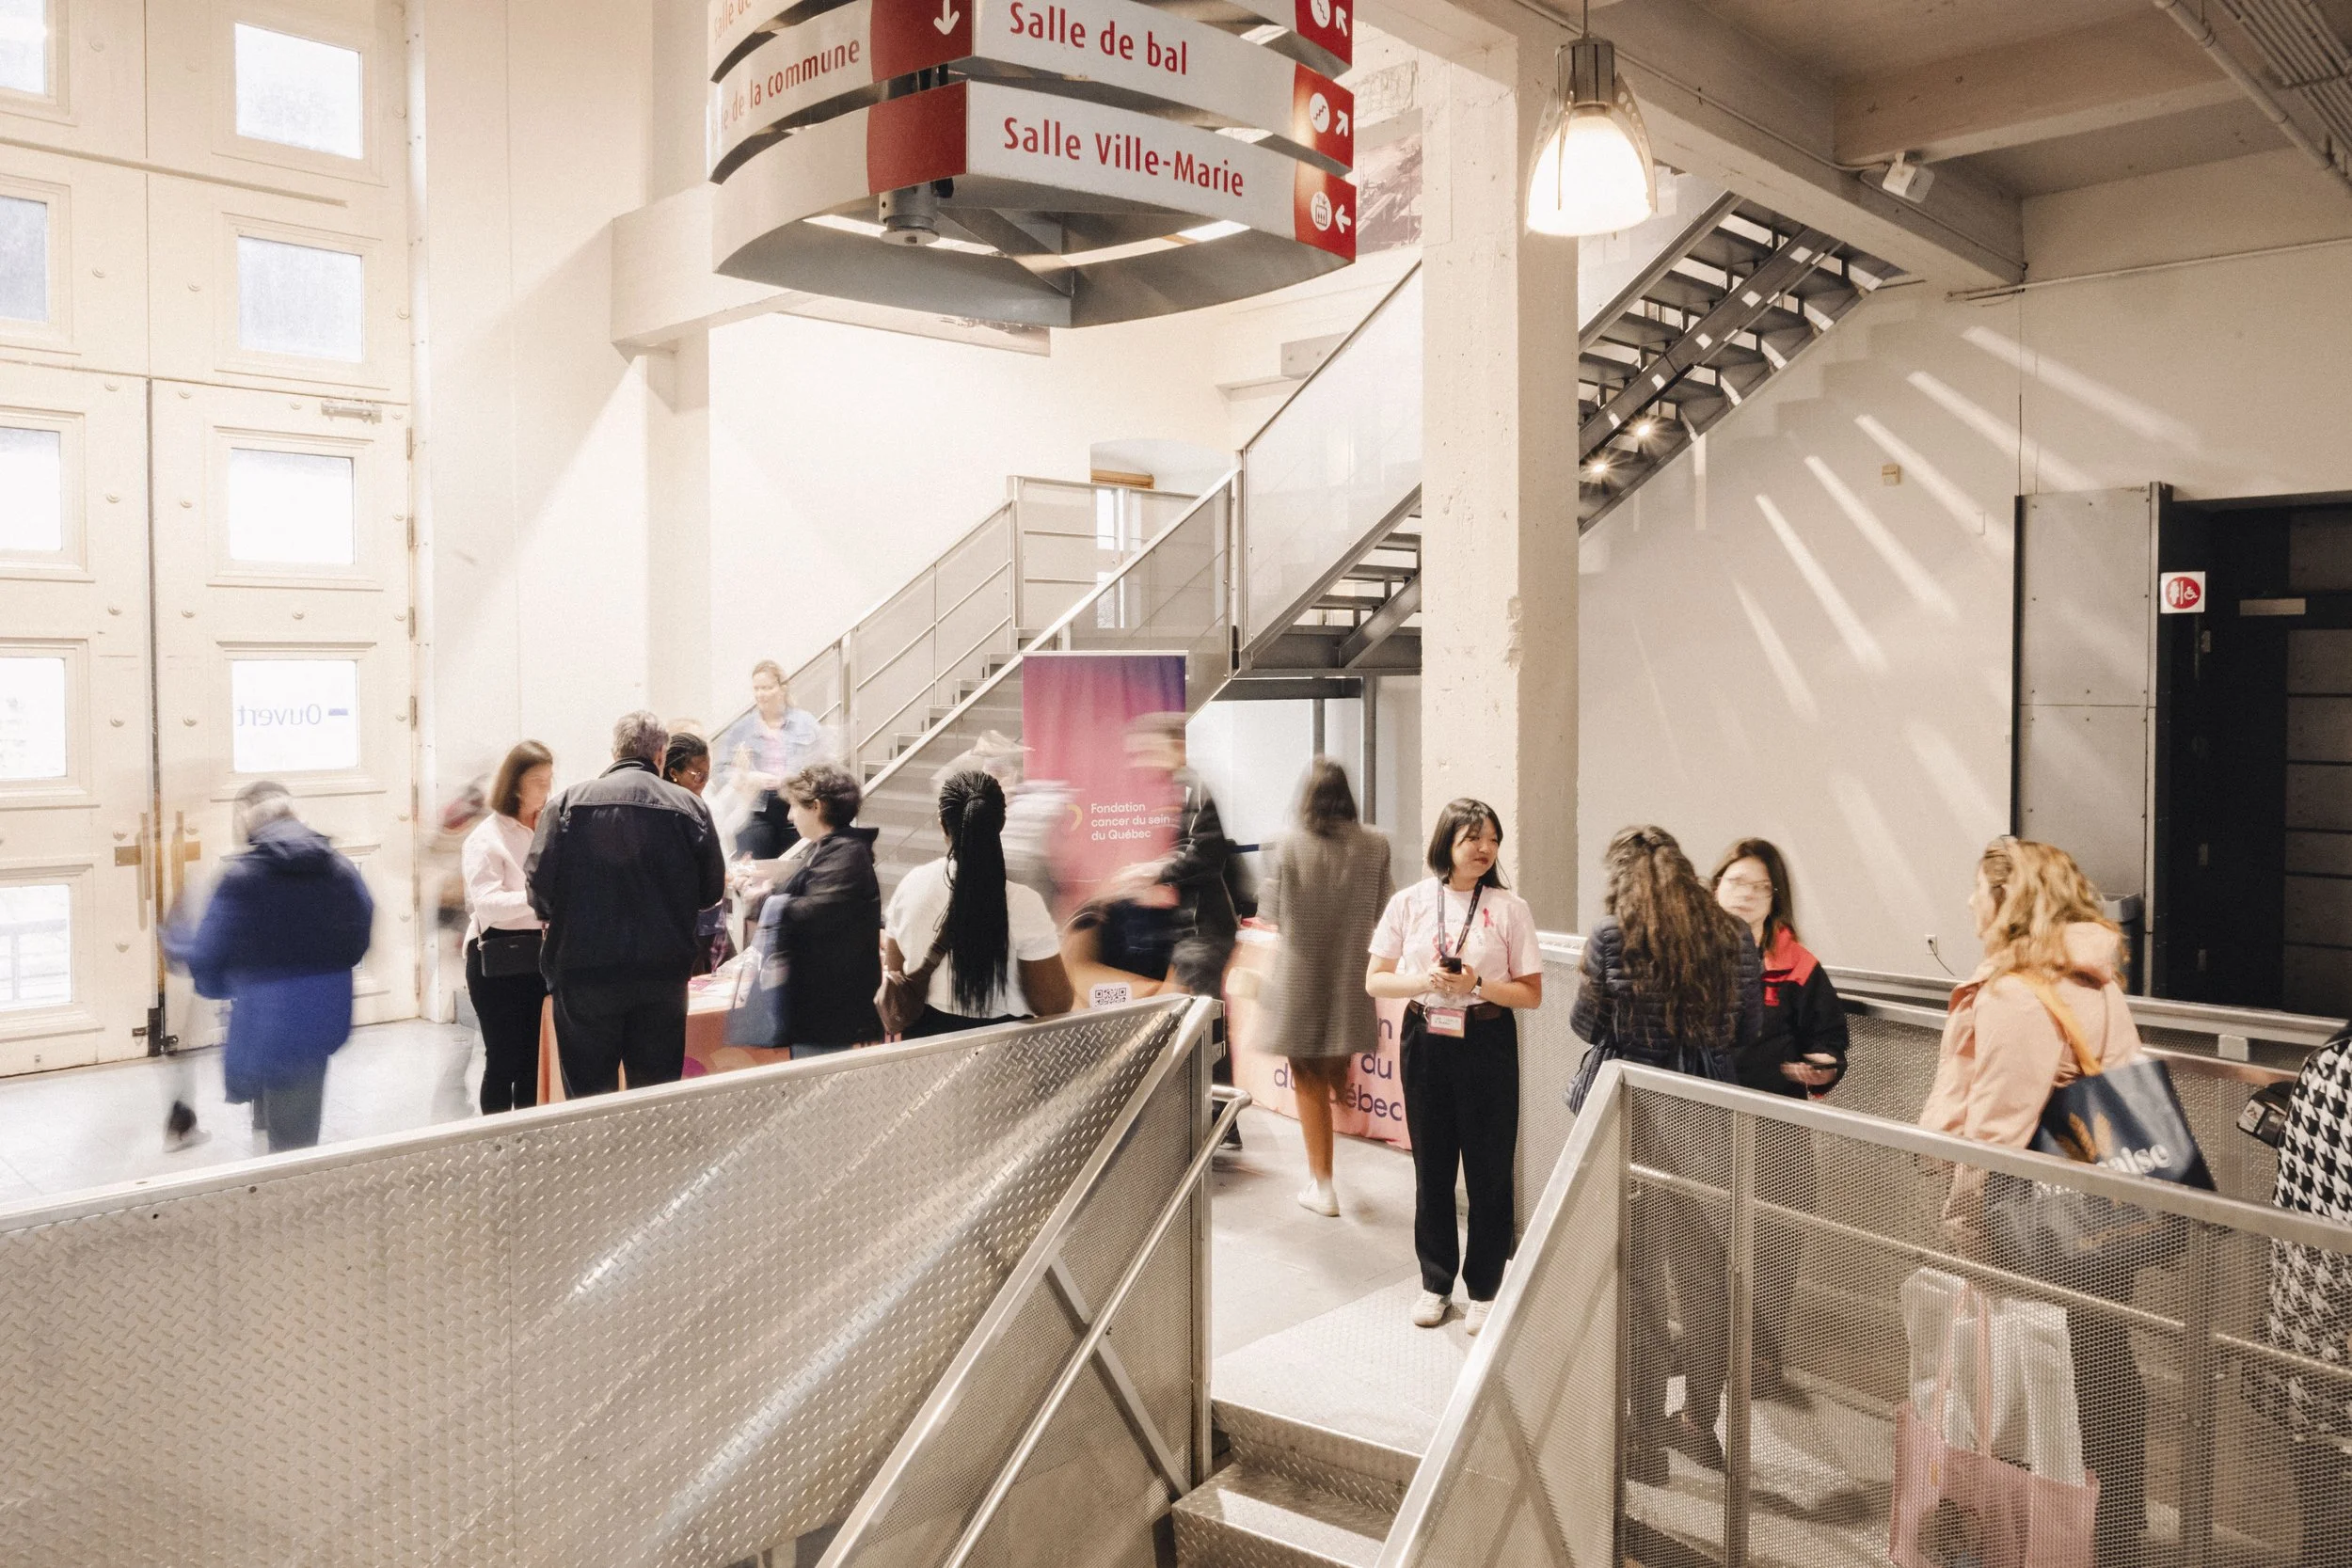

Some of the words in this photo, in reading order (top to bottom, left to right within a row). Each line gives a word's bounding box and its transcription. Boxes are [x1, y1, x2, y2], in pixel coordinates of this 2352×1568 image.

[1009, 2, 1086, 48] Salle
[1100, 21, 1134, 60] de
[1147, 31, 1186, 75] bal
[732, 90, 745, 122] de
[750, 79, 761, 110] la
[768, 40, 860, 98] commune
[1004, 118, 1081, 161] Salle
[1095, 133, 1244, 197] Ville-Marie
[1091, 801, 1146, 814] Fondation
[1091, 817, 1130, 828] cancer
[1132, 816, 1146, 826] du
[1148, 813, 1170, 825] sein
[1091, 831, 1106, 841] du
[1108, 828, 1152, 840] Québec
[1360, 1052, 1392, 1080] du
